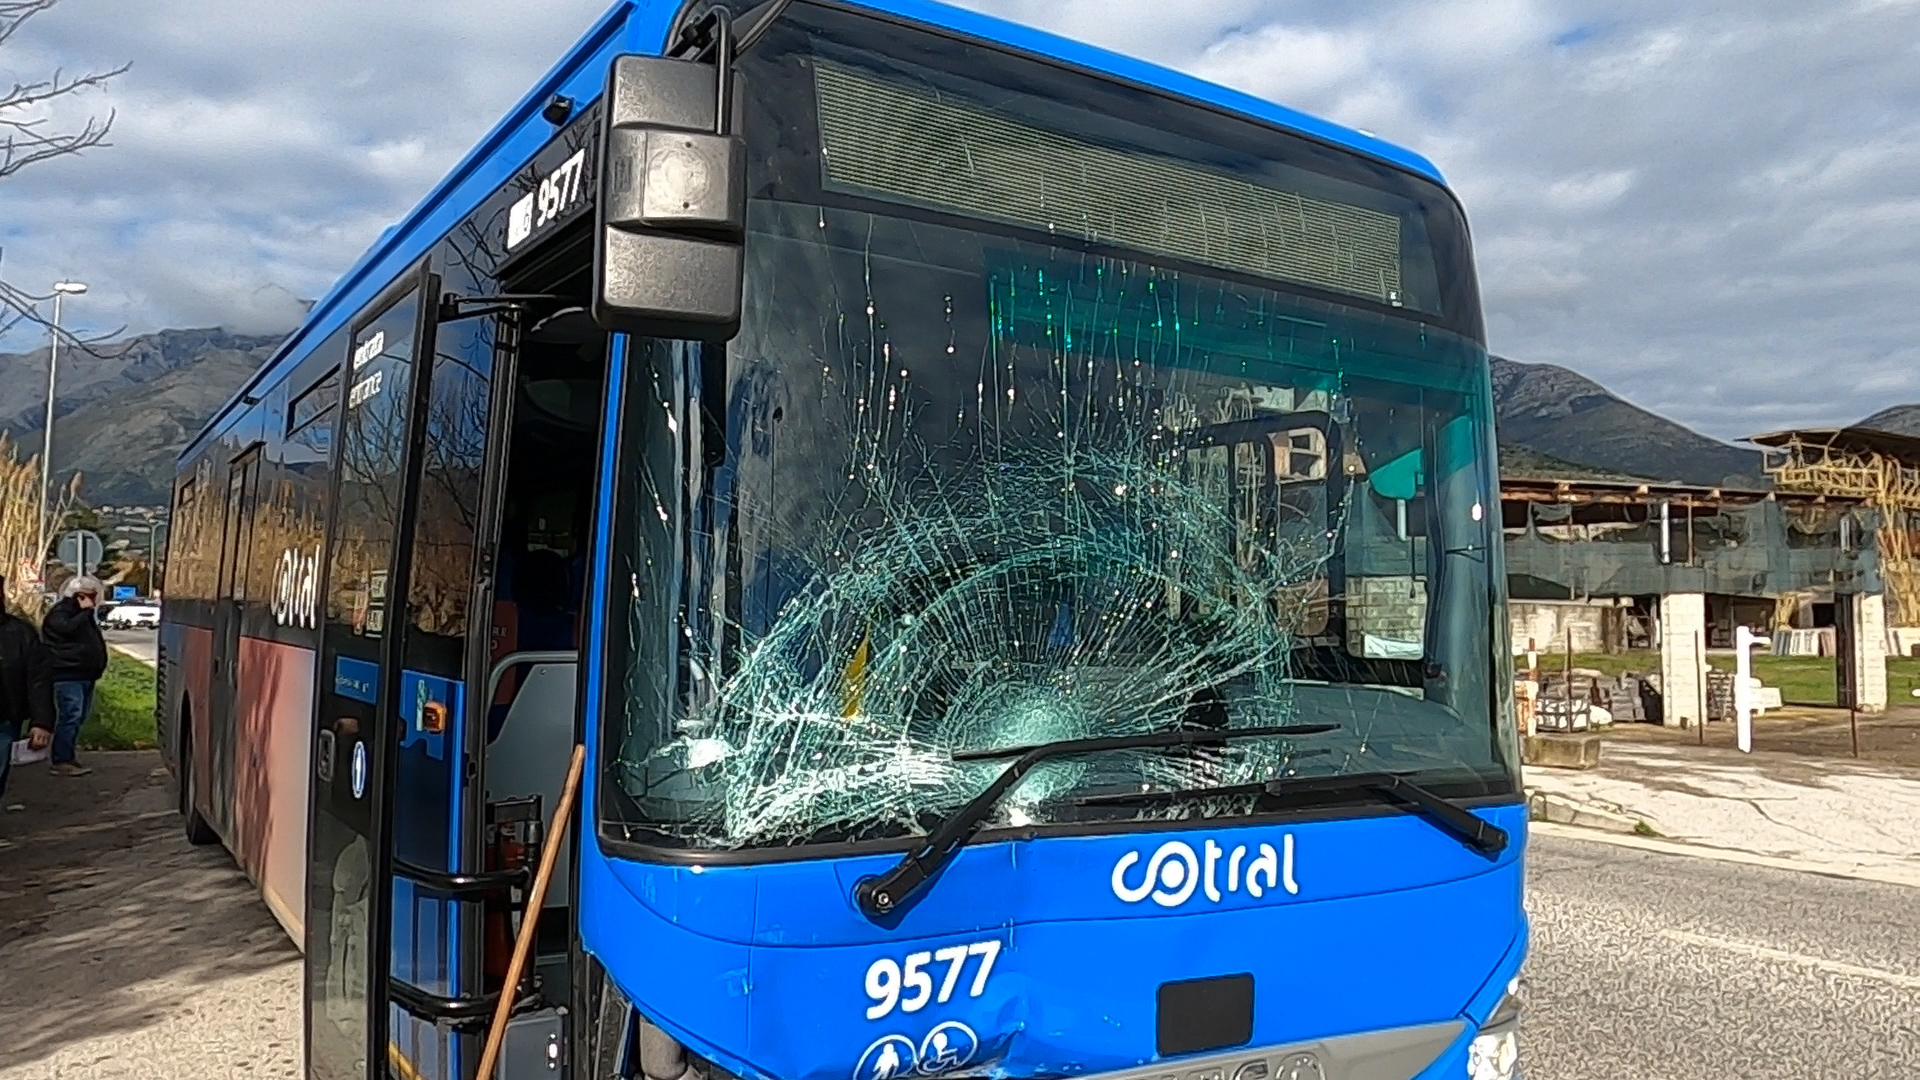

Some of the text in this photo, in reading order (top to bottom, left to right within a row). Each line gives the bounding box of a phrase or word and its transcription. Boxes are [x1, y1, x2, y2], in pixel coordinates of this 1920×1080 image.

[537, 148, 586, 227] 9577
[1112, 834, 1298, 907] cotral
[865, 941, 1001, 1019] 9577
